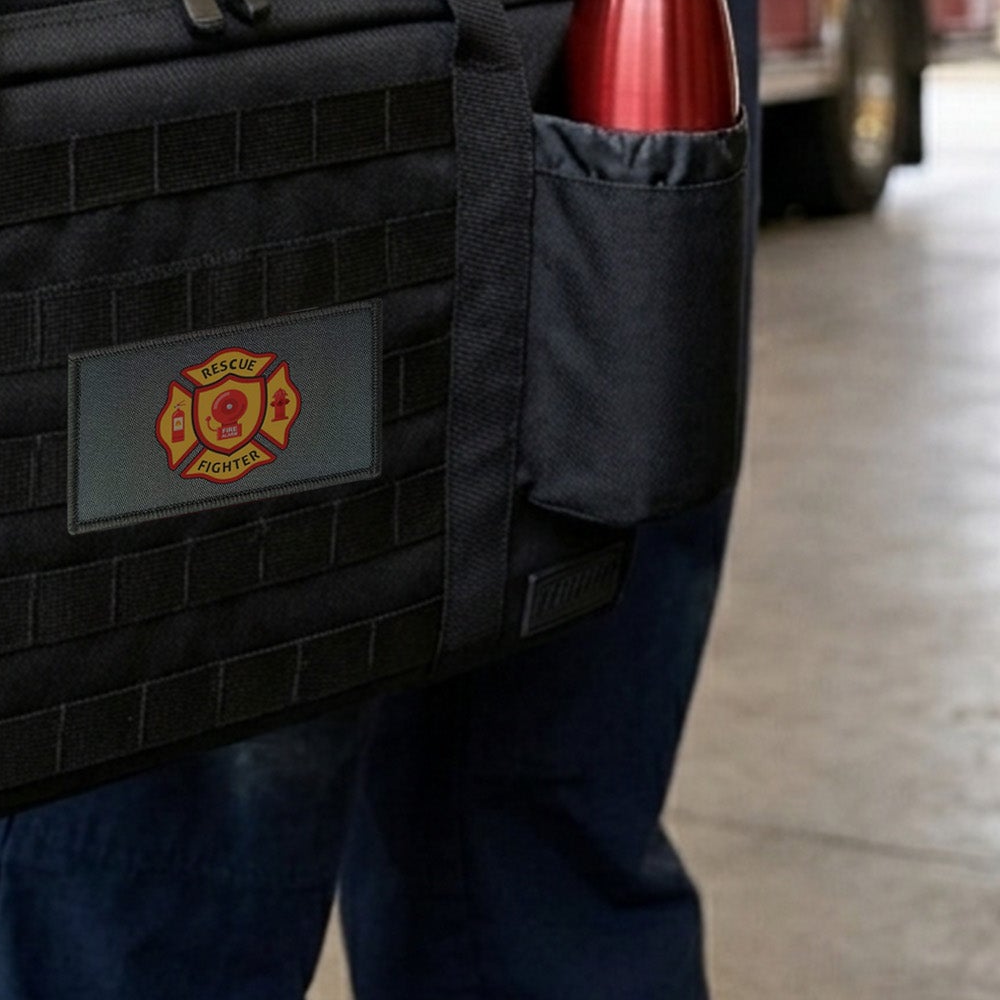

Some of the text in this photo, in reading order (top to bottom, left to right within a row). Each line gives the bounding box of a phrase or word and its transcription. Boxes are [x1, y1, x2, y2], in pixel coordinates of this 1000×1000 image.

[201, 358, 257, 379] RESCUE
[221, 426, 238, 434] FIRE
[197, 450, 260, 473] FIGHTER
